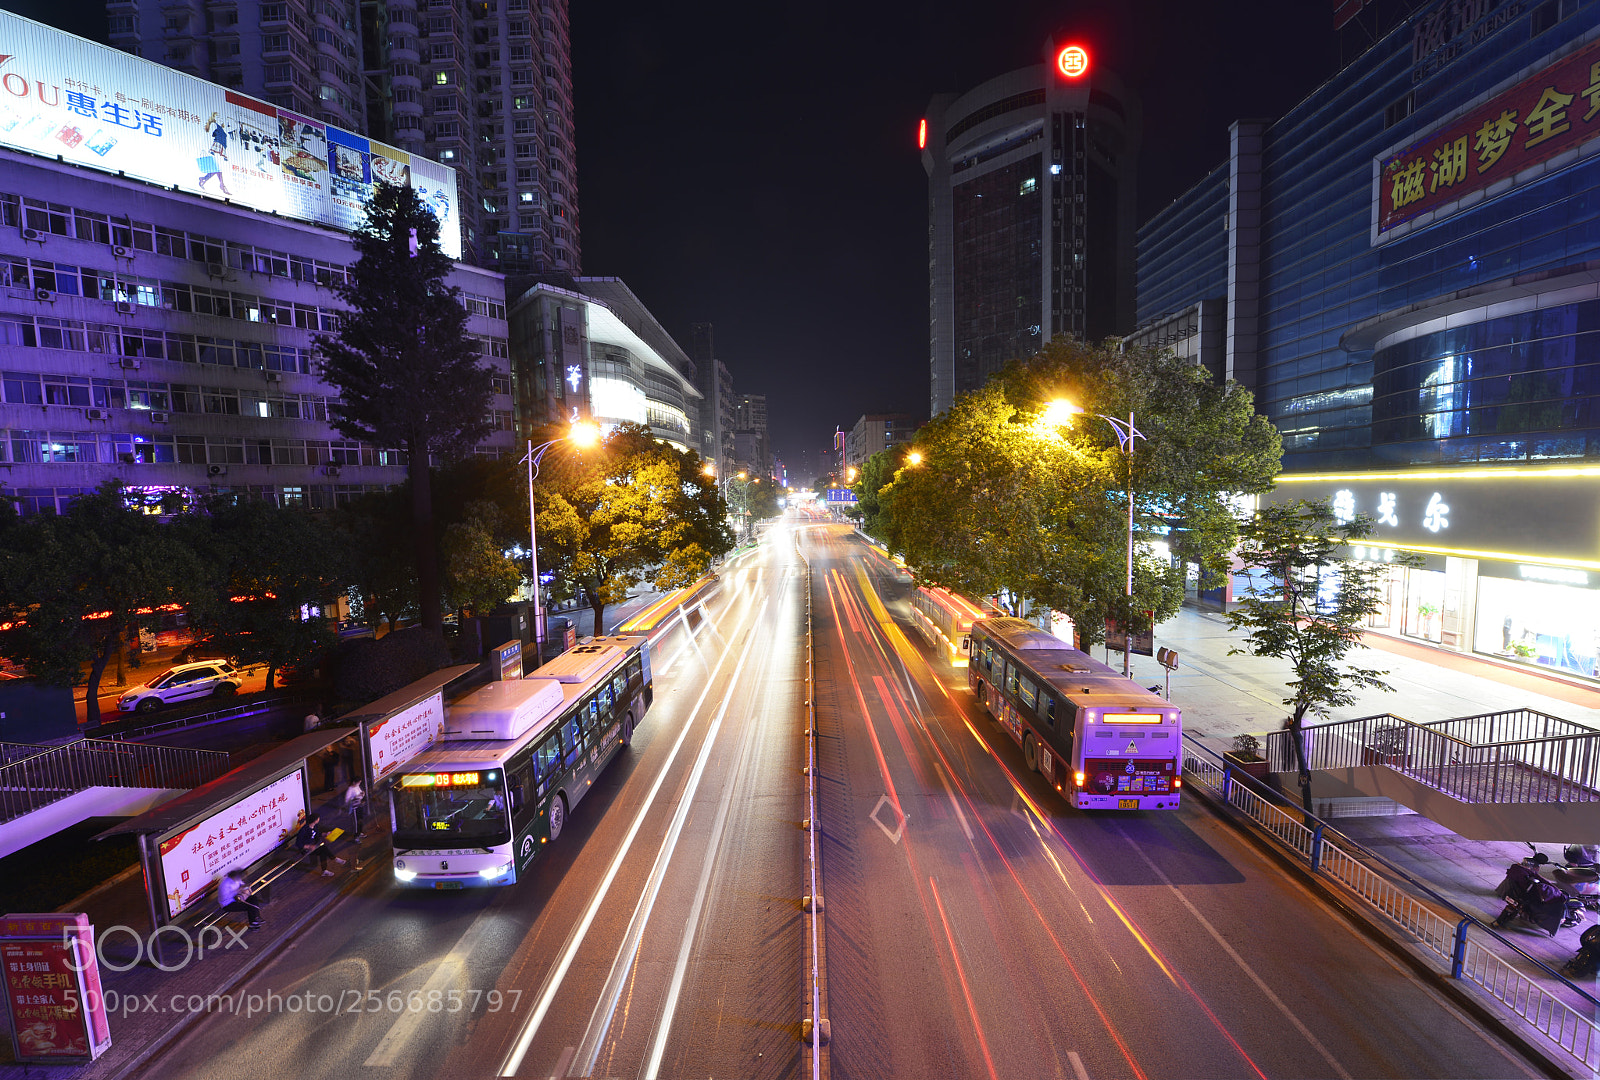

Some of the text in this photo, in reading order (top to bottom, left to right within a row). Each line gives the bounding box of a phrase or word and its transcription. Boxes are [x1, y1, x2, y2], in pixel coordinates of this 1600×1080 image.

[1470, 3, 1519, 44] MENG
[65, 89, 163, 137] 惠生活
[436, 774, 450, 785] 09
[192, 793, 288, 854] 社会主义核心价值观
